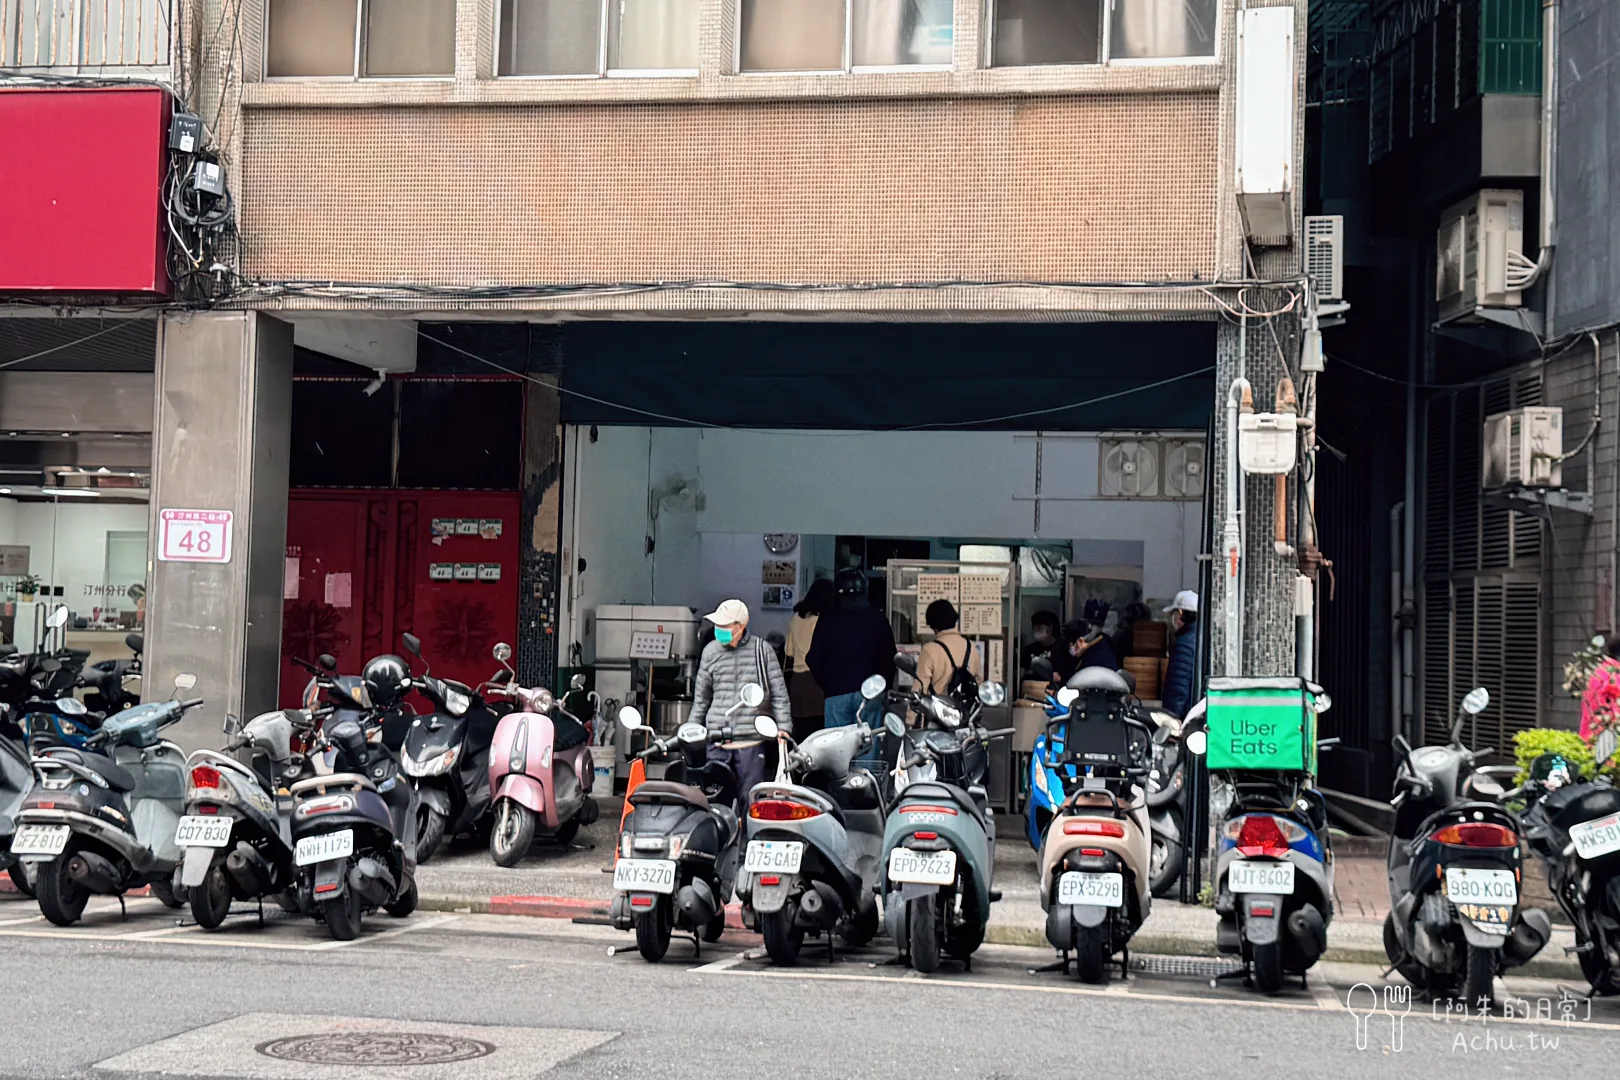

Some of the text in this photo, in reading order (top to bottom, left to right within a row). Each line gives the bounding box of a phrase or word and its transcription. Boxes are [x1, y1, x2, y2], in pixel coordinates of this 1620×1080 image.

[178, 530, 211, 553] 48
[83, 584, 126, 597] 汀州分行
[1230, 719, 1278, 736] Uber
[1230, 738, 1278, 755] Eats
[893, 857, 951, 875] EPD-9623
[617, 866, 672, 885] NKY-3270
[1062, 880, 1120, 898] EPX-5298
